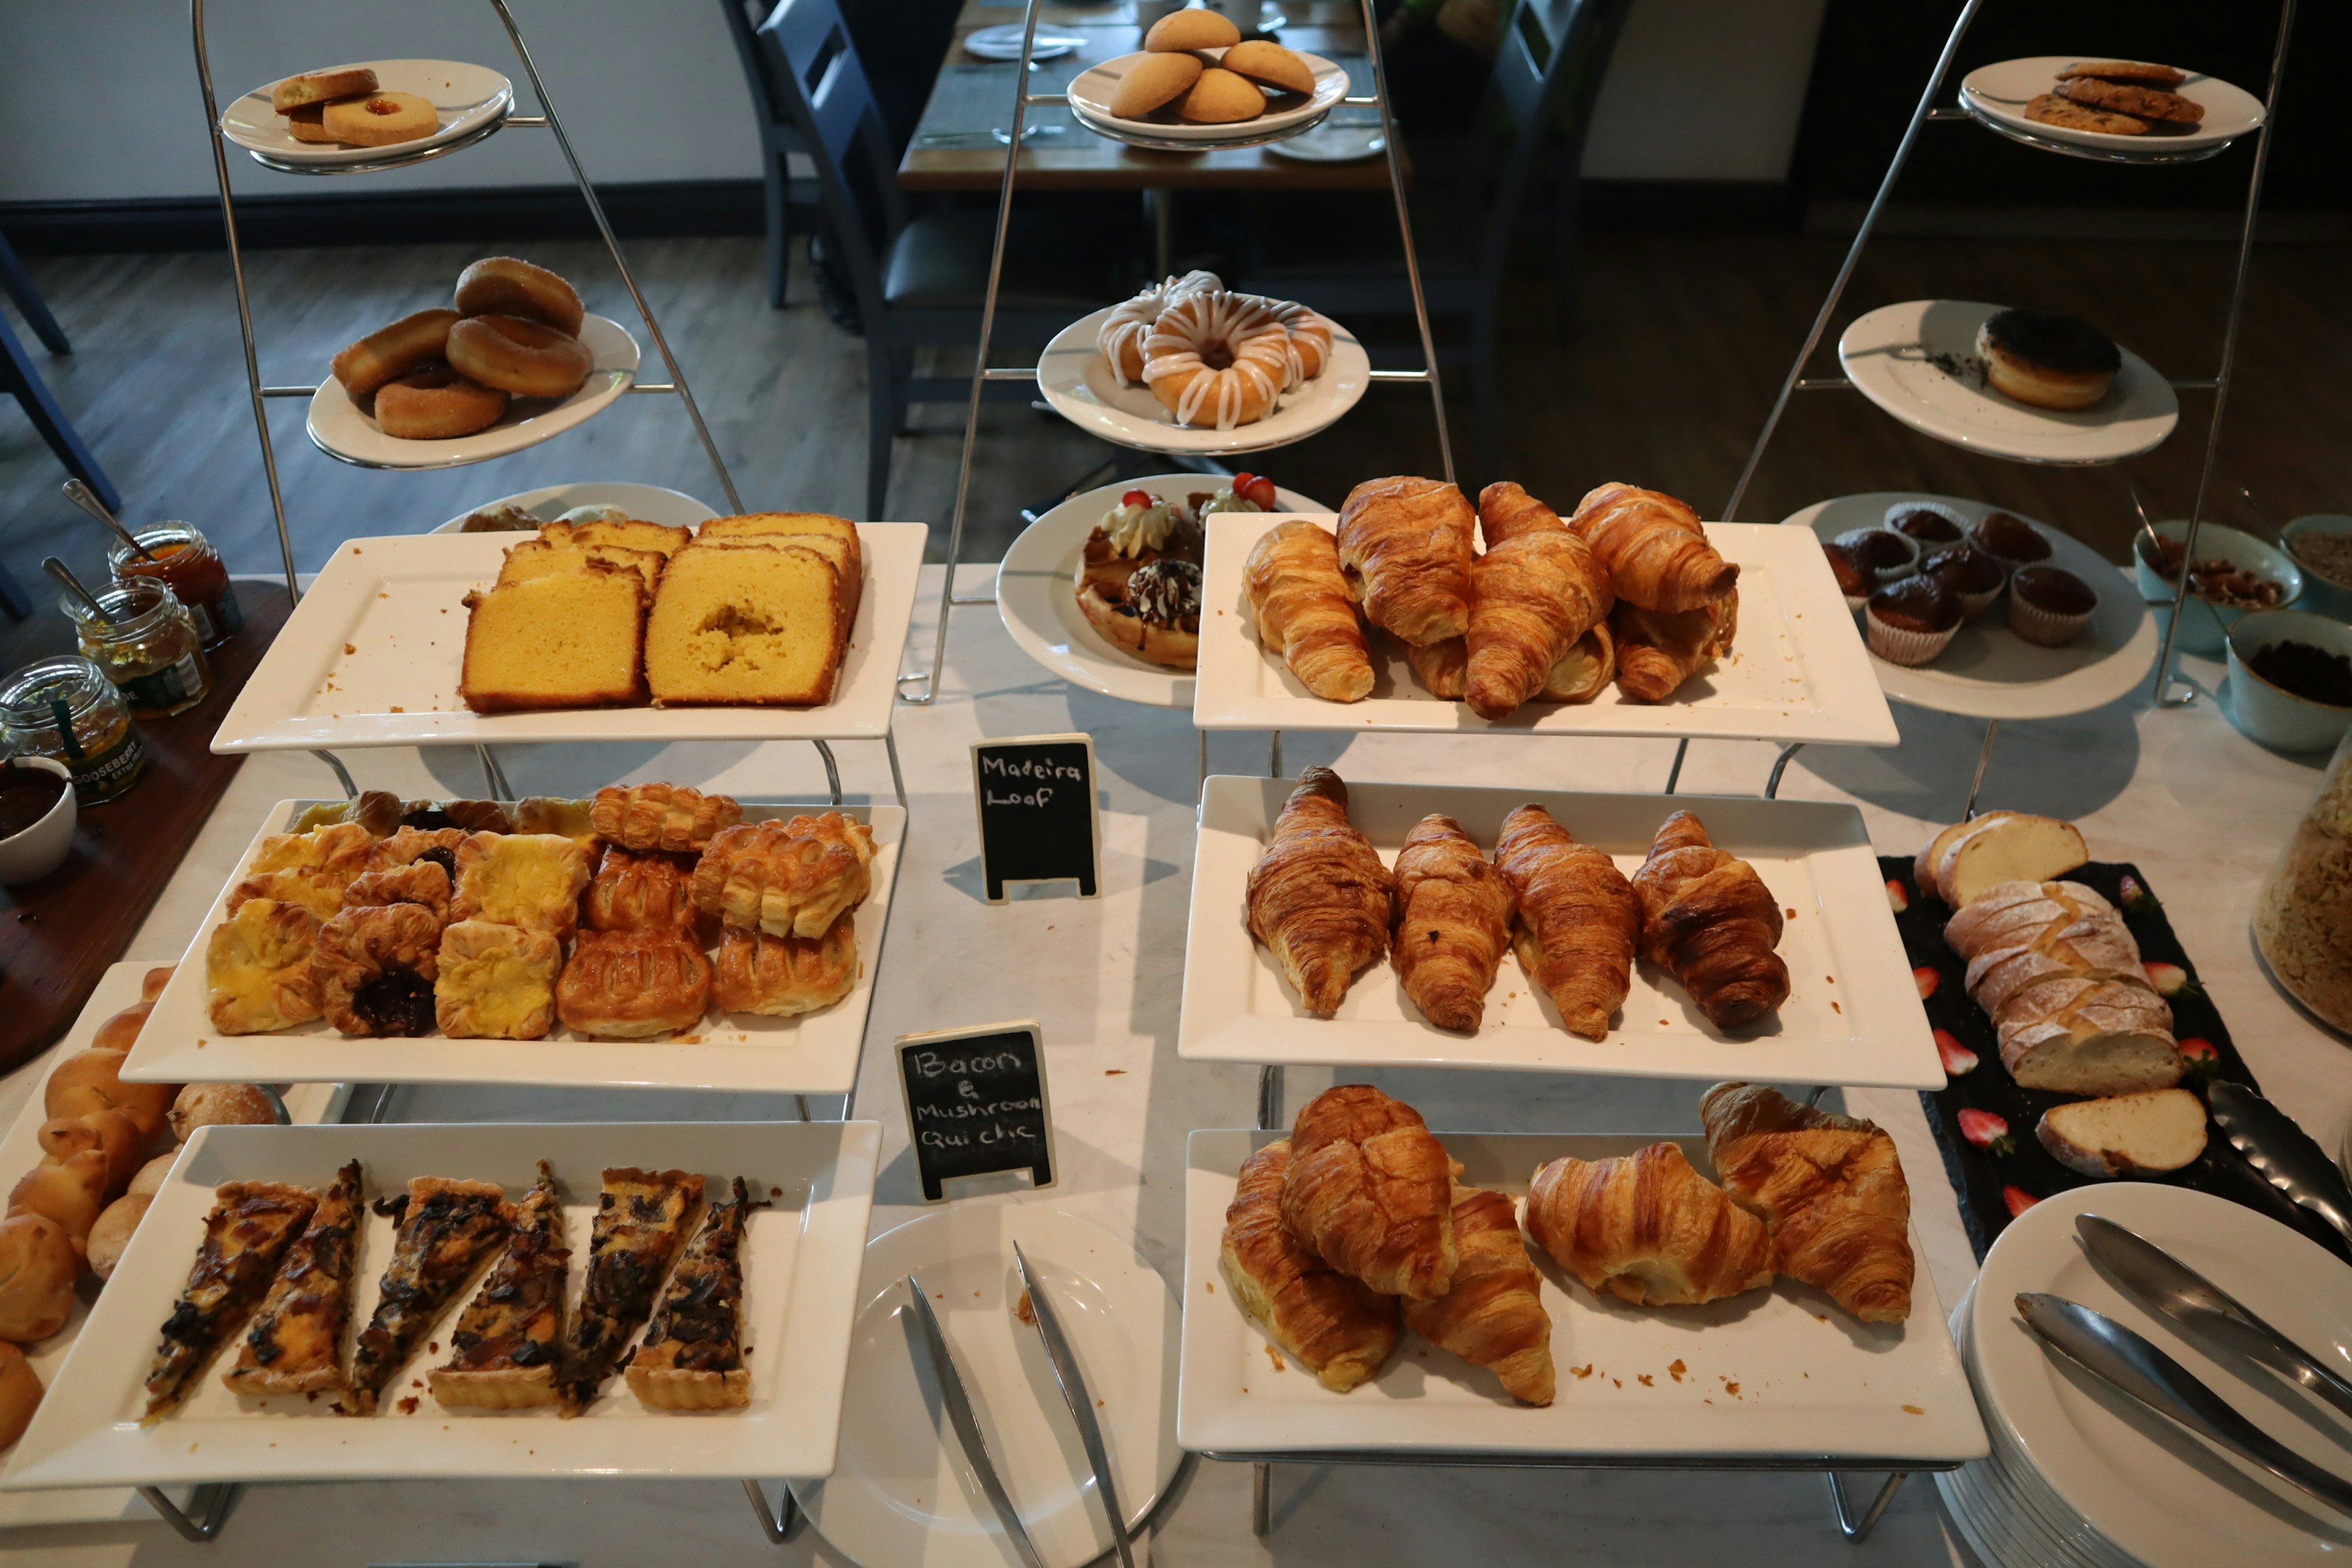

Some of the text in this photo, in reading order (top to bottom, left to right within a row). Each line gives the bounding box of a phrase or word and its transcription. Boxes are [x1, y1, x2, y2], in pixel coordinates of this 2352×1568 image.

[71, 740, 136, 785] GOOSEBERRY
[111, 761, 134, 779] EXTRA
[982, 755, 1082, 782] Madeira
[914, 1051, 1021, 1078] Bacon
[916, 1097, 1042, 1121] Mushroom
